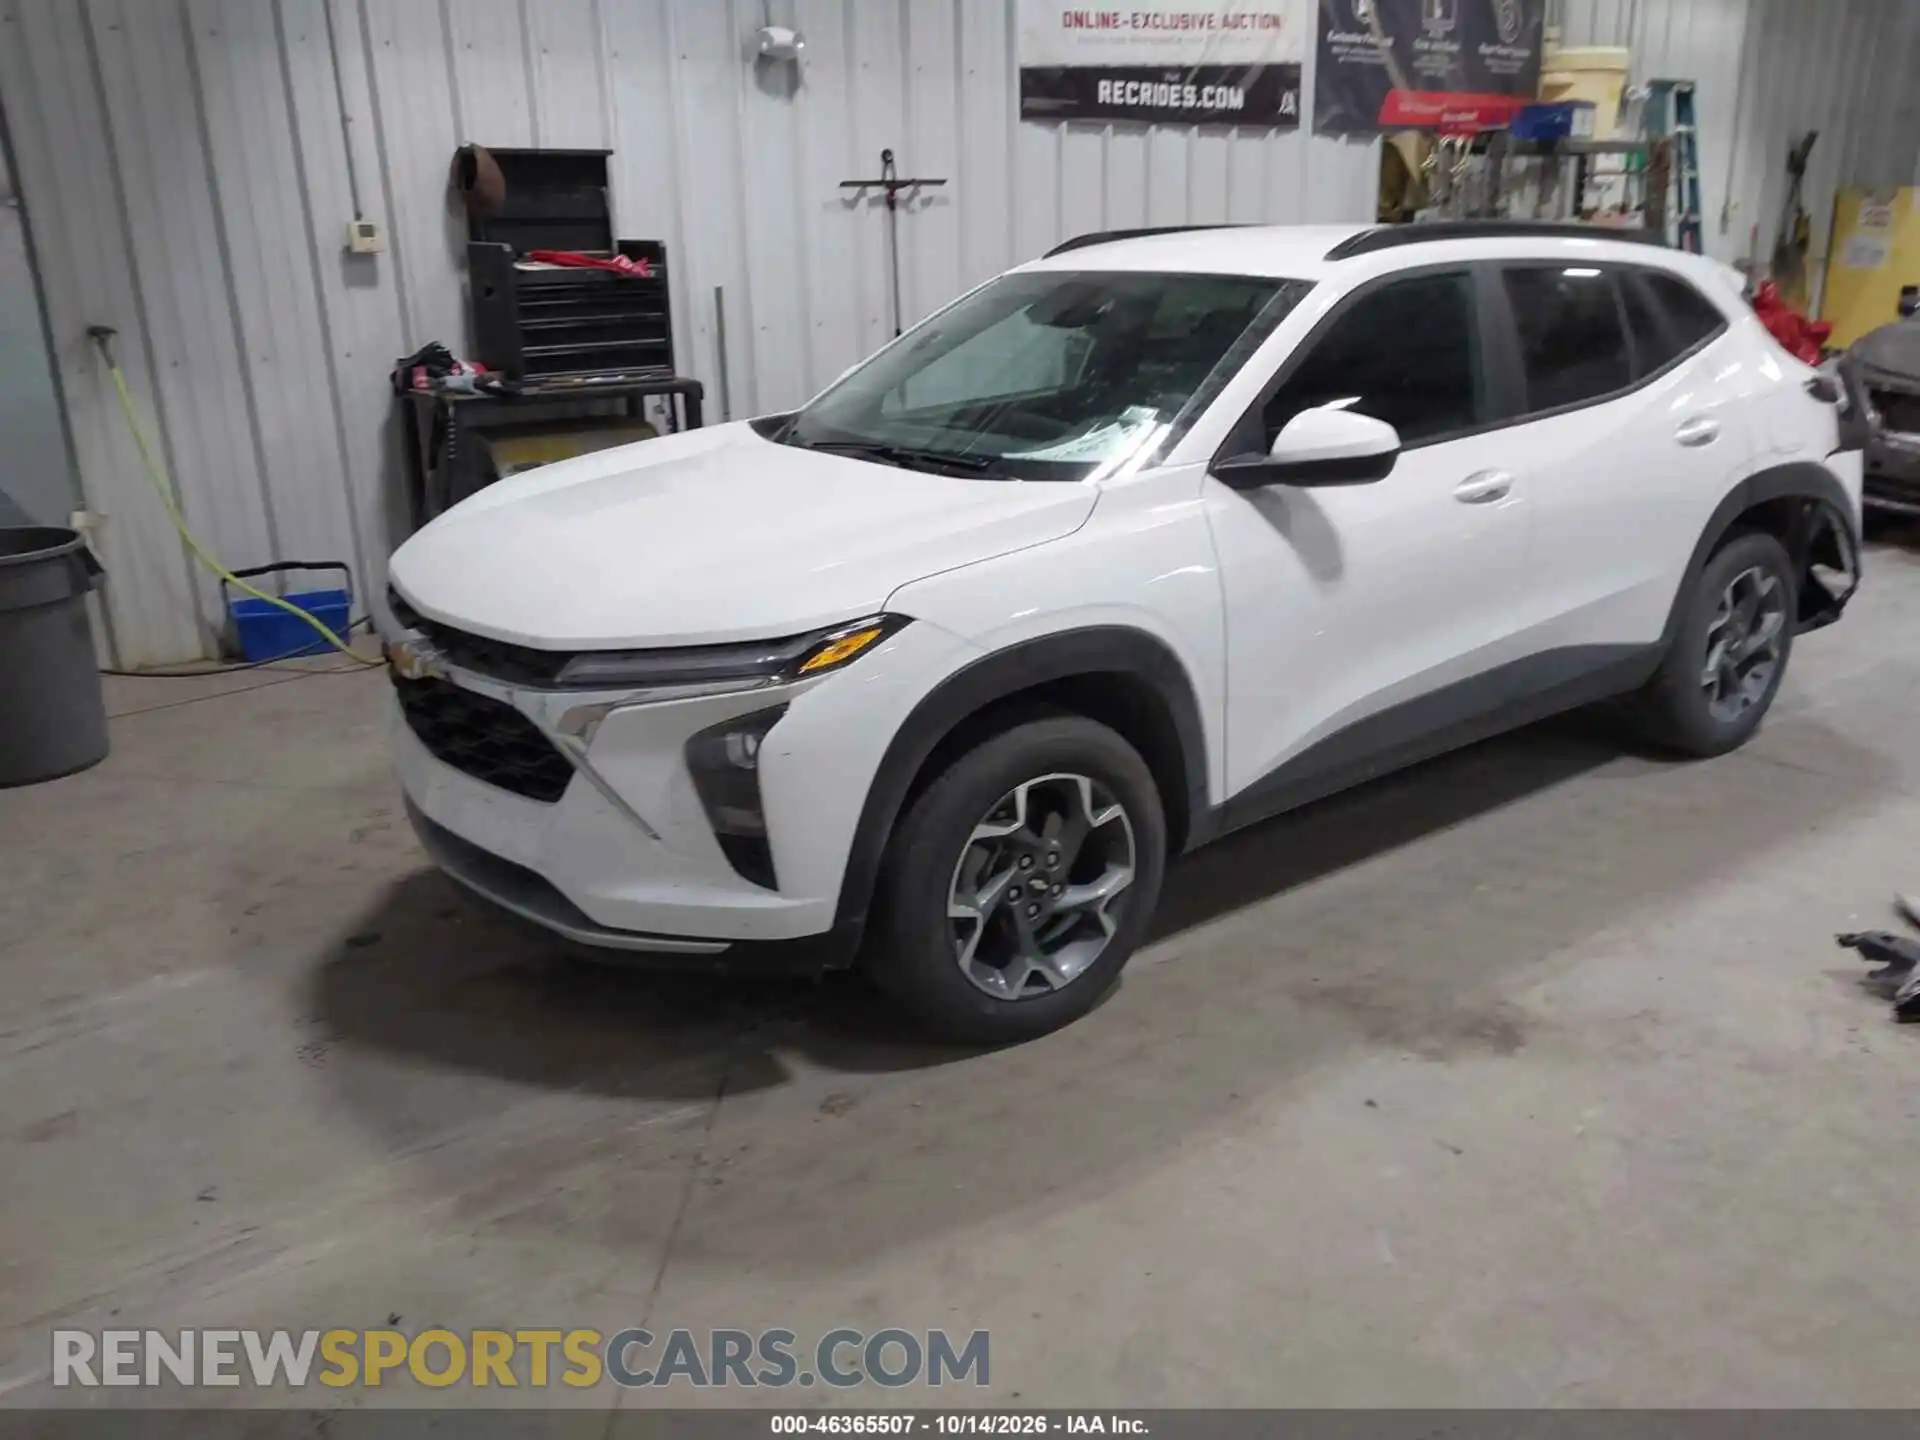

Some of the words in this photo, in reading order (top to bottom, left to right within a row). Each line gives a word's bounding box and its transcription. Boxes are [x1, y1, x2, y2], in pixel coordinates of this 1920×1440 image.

[1062, 11, 1216, 29] ONLINE-EXCLUSIVE
[1222, 13, 1282, 29] AUCTION
[1098, 80, 1244, 110] RECRIDES.COM
